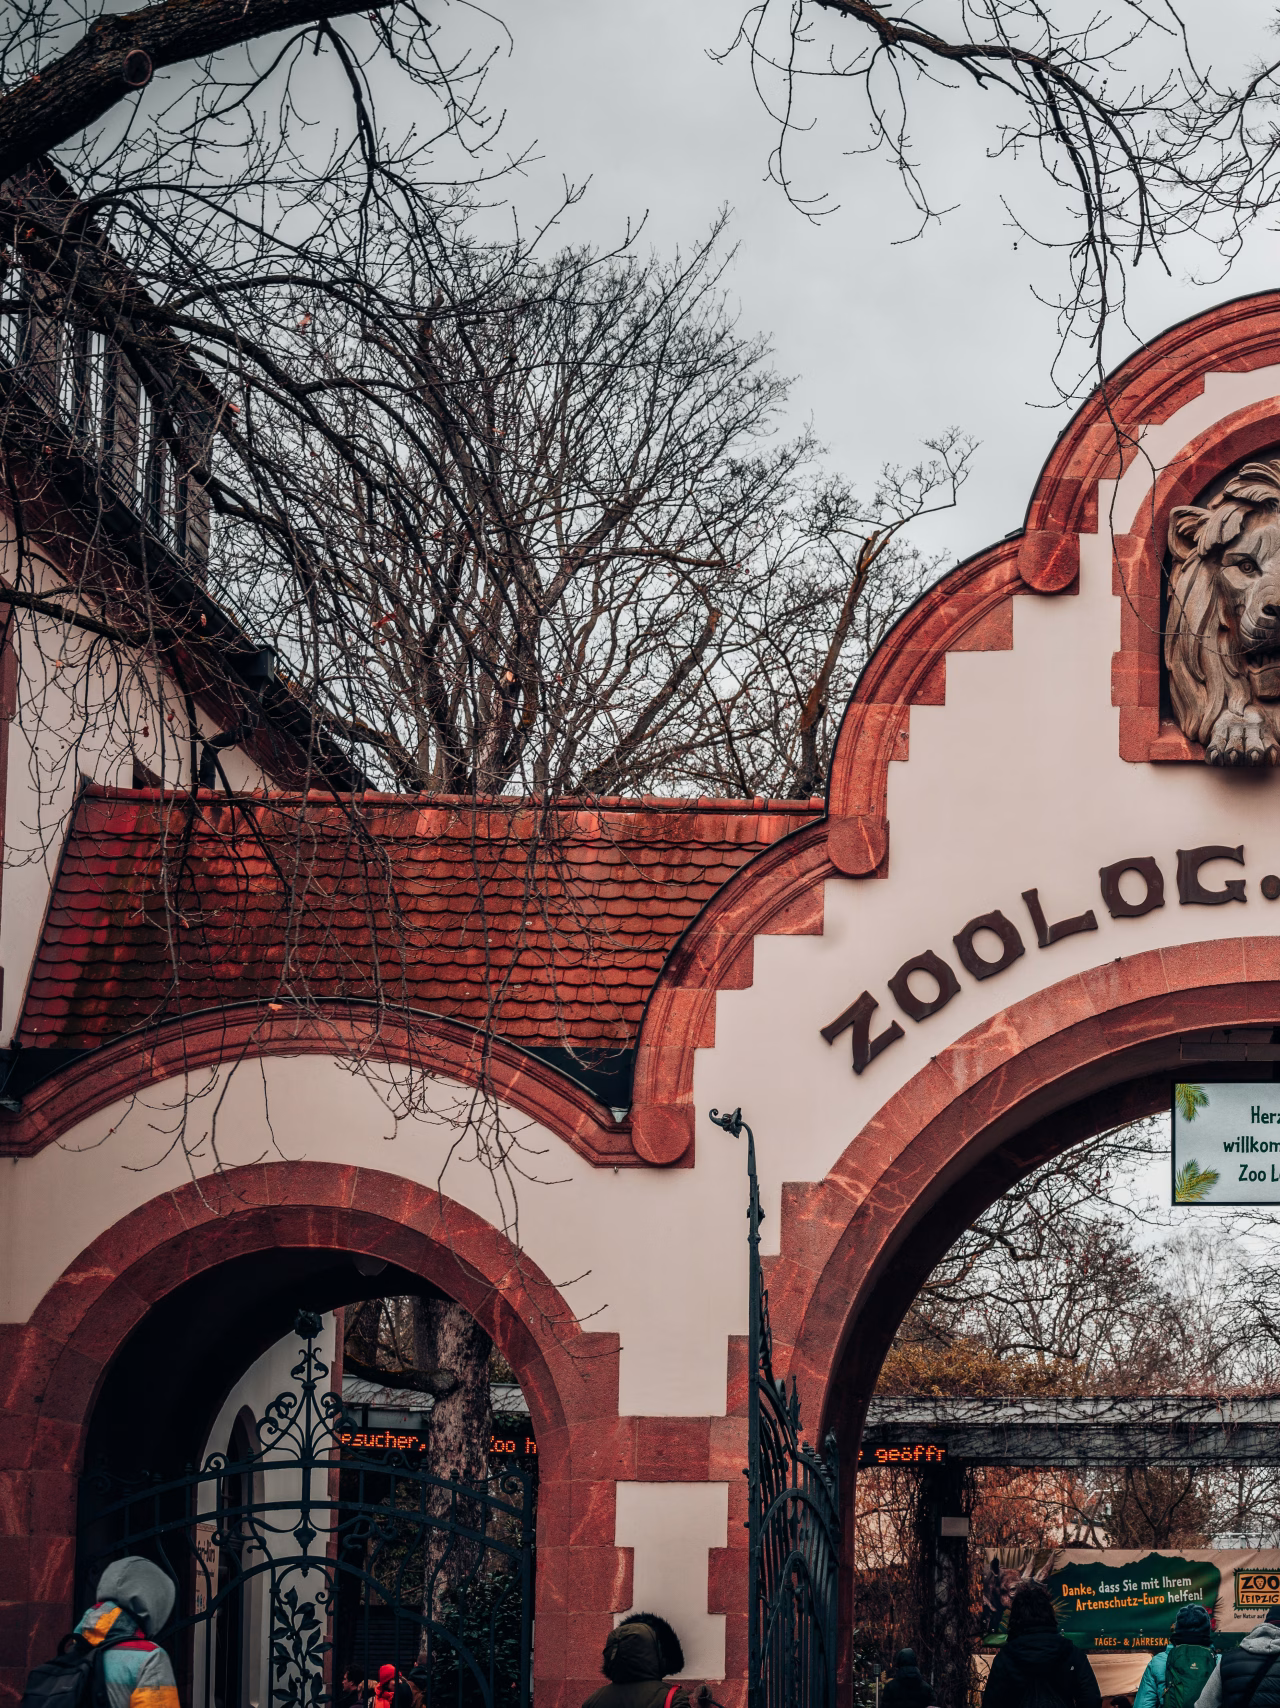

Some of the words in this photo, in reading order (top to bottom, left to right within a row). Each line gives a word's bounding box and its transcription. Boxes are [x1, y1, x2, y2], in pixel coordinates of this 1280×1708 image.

[1238, 1164, 1267, 1182] Zoo
[341, 1430, 427, 1452] esucher,
[1062, 1583, 1096, 1597] Danke,
[1098, 1581, 1120, 1594] dass
[1122, 1579, 1138, 1592] Sie
[1141, 1577, 1160, 1590] mit
[1162, 1576, 1192, 1589] Ihrem
[1241, 1575, 1280, 1590] ZOO
[1076, 1592, 1165, 1611] Artenschutz-Euro
[1167, 1587, 1204, 1603] helfen!
[1240, 1594, 1279, 1603] LEIPZIG
[1094, 1637, 1121, 1646] TAGES-
[1123, 1637, 1130, 1646] &
